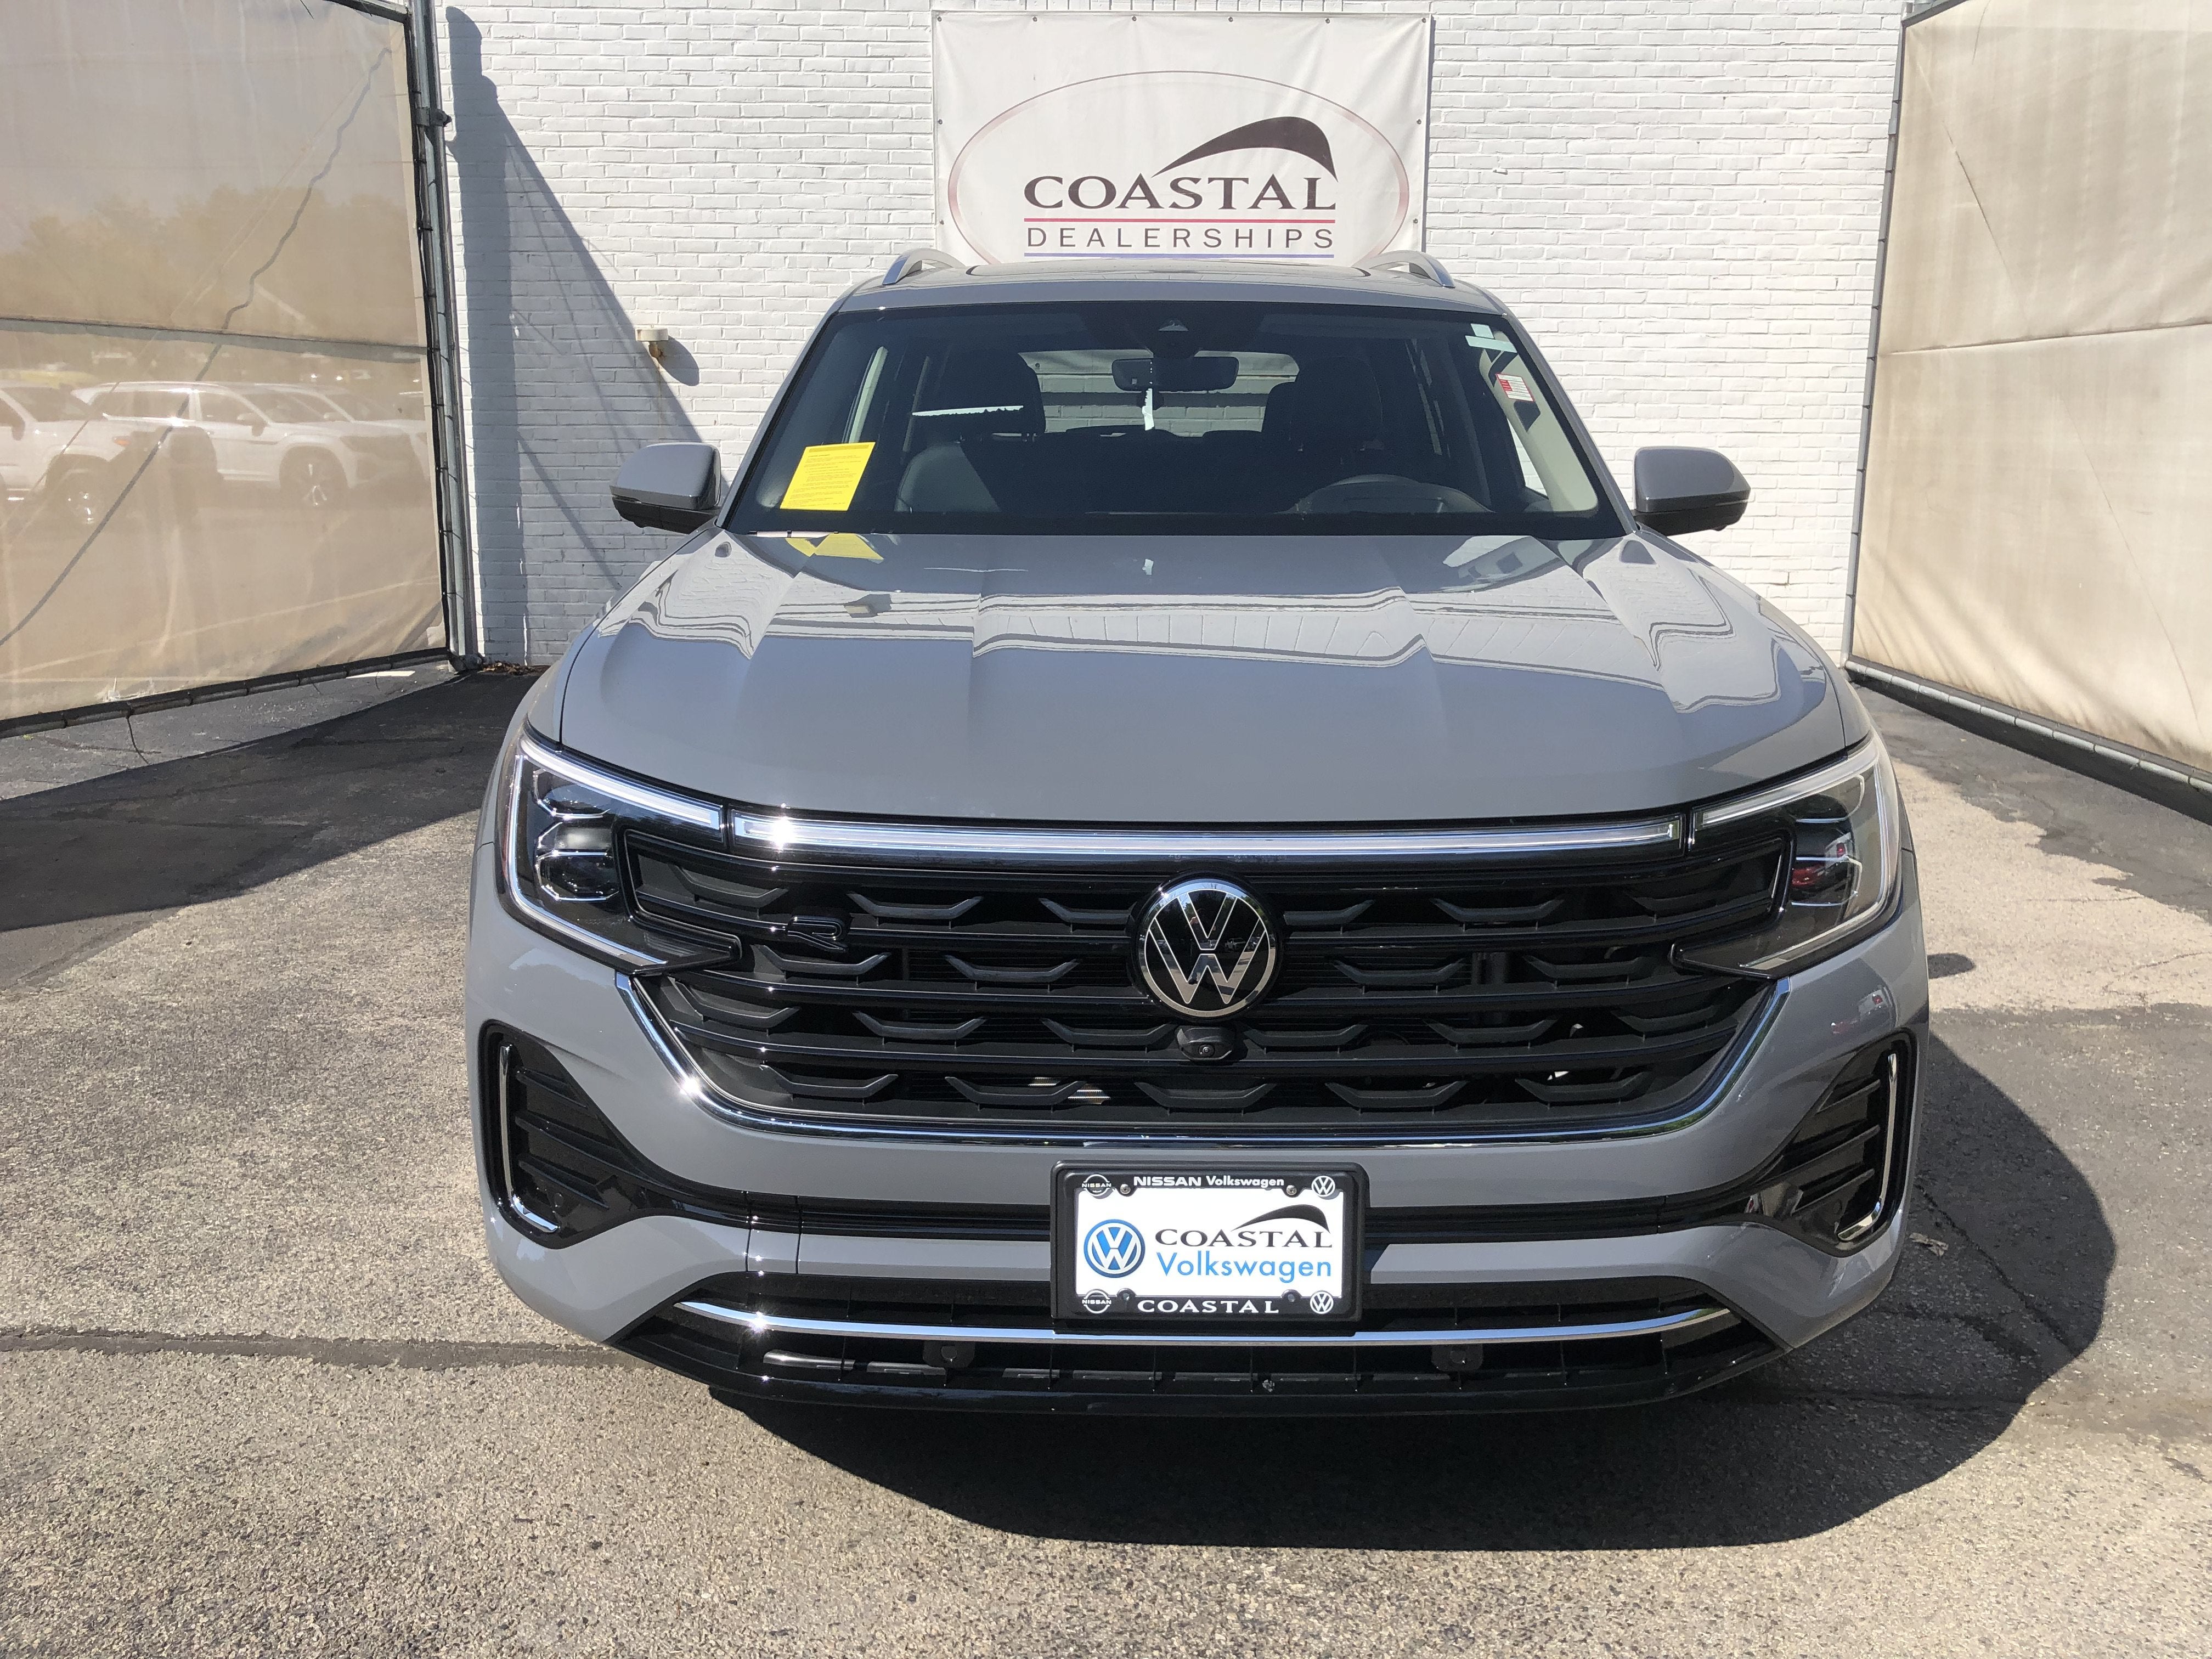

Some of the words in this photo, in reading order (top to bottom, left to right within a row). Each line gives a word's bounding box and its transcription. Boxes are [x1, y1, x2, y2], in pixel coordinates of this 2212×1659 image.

[1024, 173, 1336, 210] COASTAL
[1027, 227, 1334, 249] DEALERSHIPS
[1133, 1176, 1201, 1187] NISSAN
[1206, 1175, 1284, 1188] Volkswagen
[1155, 1228, 1333, 1248] COASTAL
[1156, 1250, 1332, 1283] Volkswagen
[1137, 1299, 1279, 1313] COASTAL
